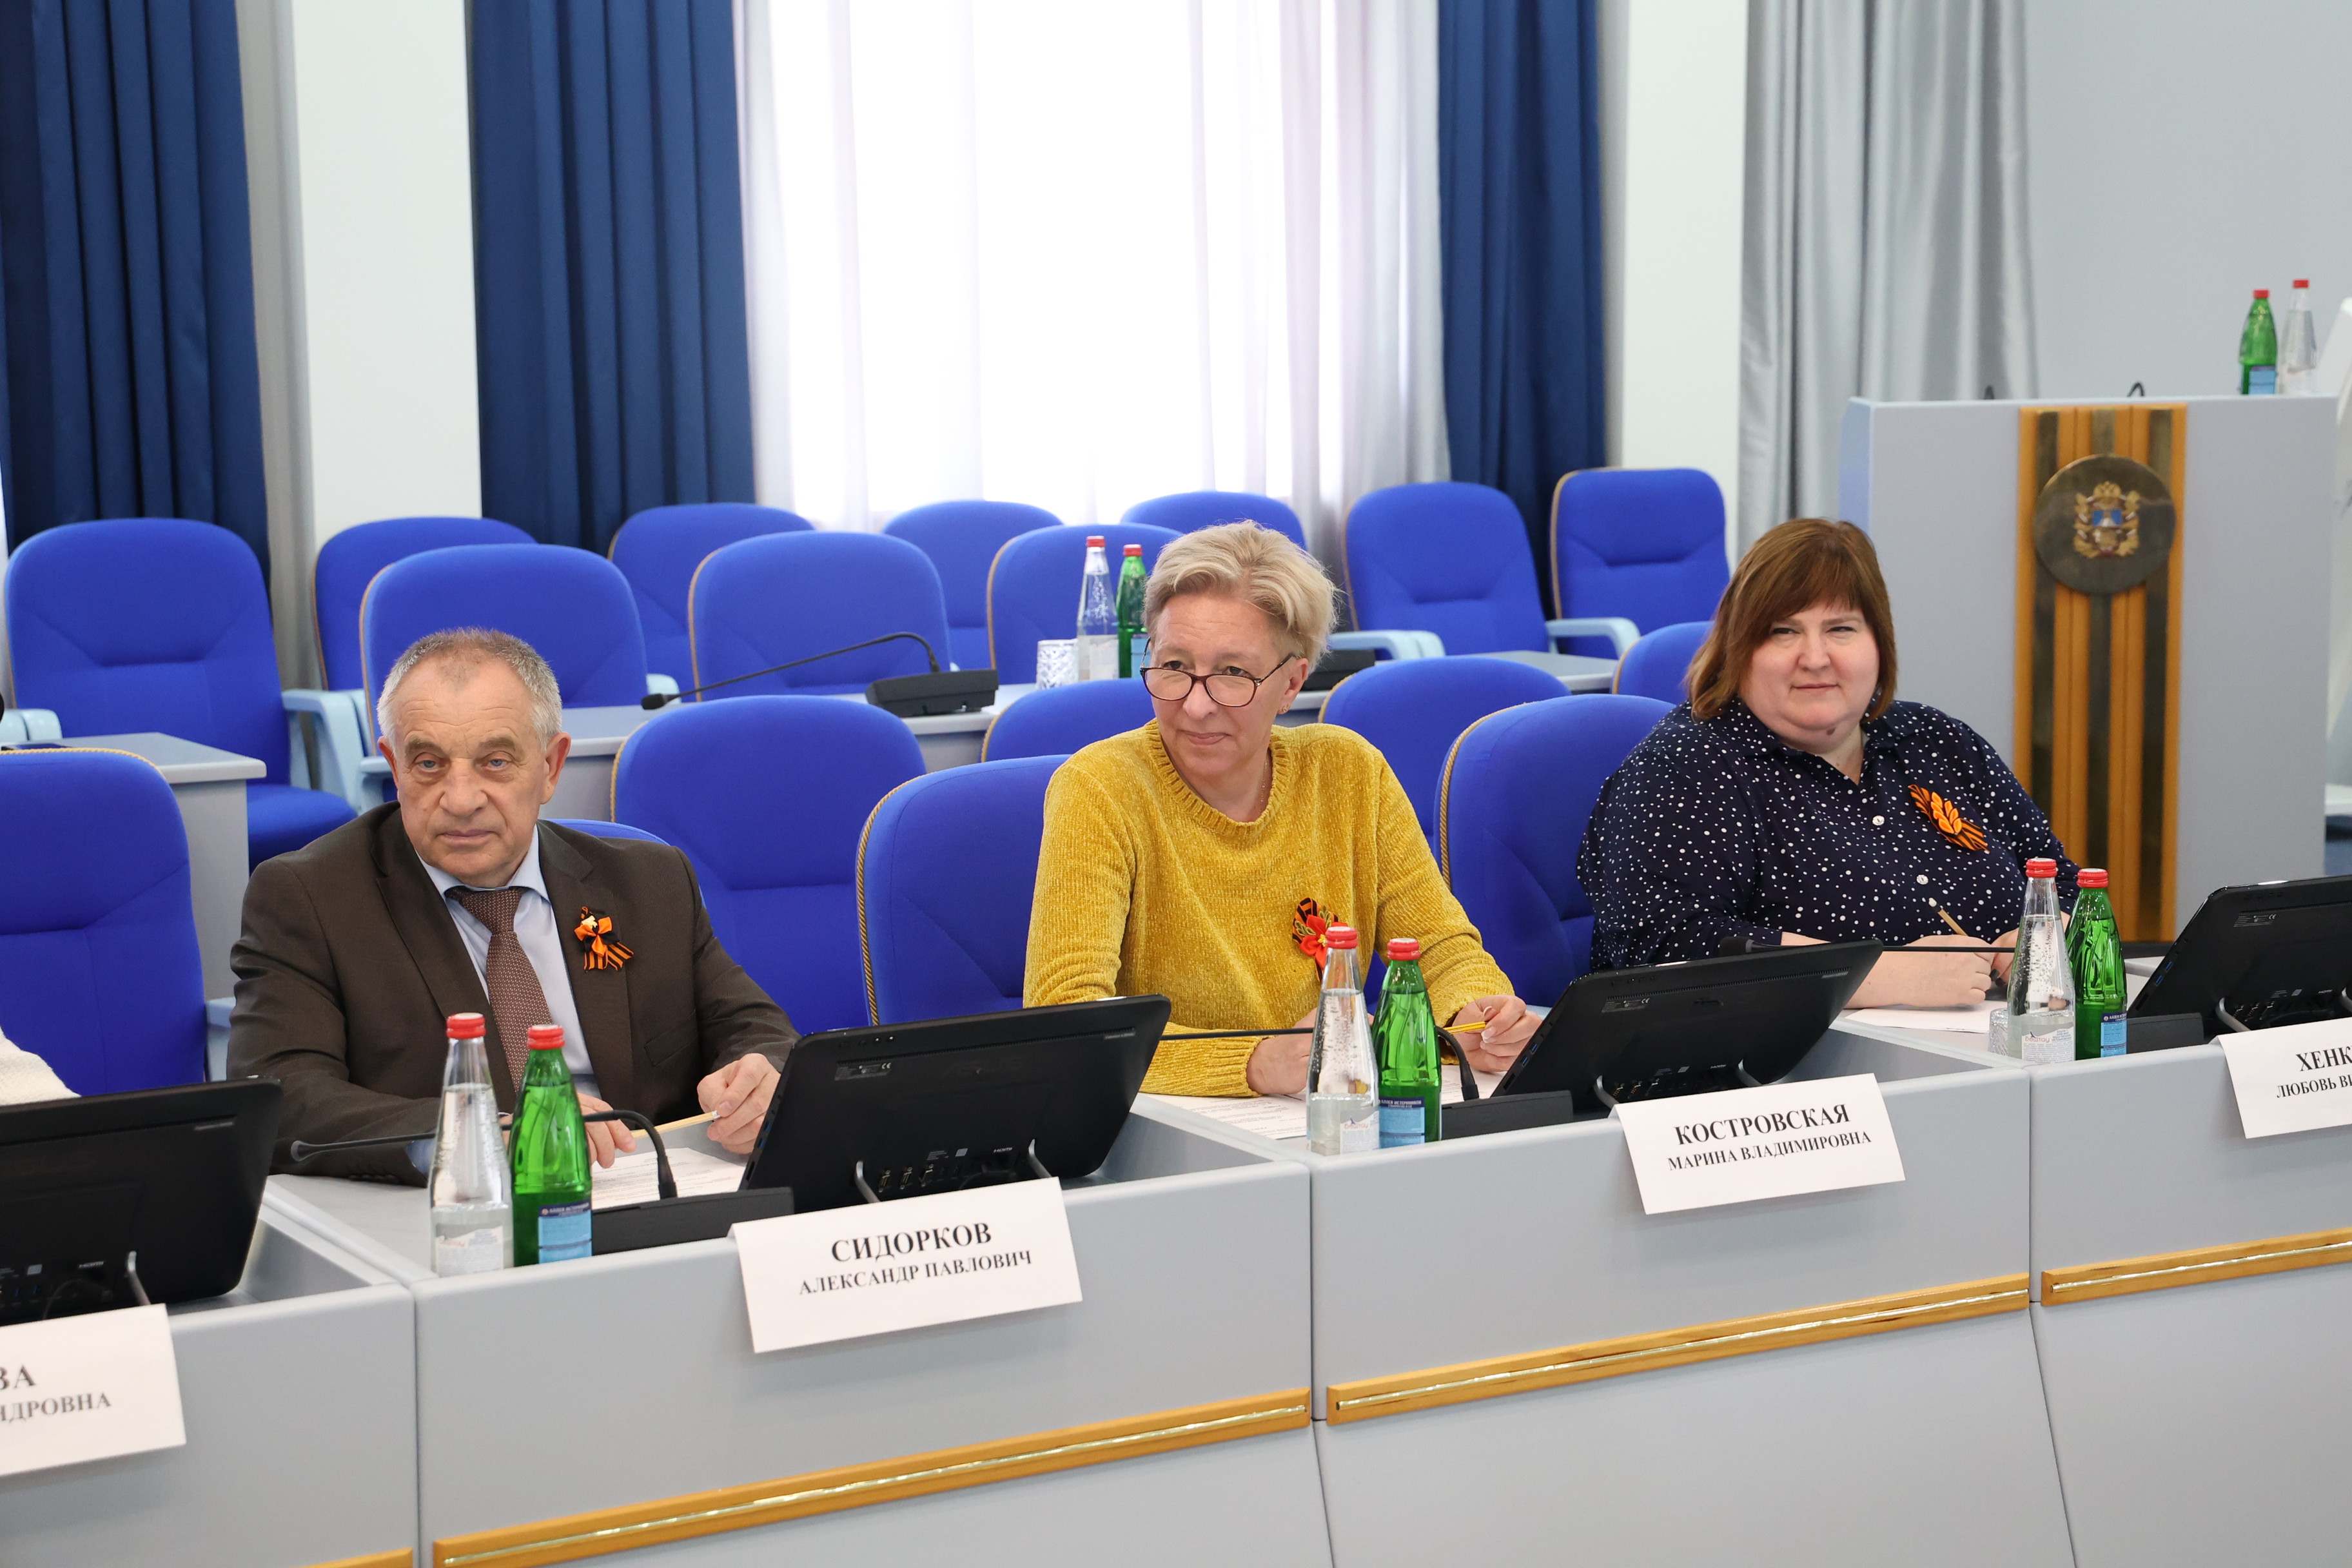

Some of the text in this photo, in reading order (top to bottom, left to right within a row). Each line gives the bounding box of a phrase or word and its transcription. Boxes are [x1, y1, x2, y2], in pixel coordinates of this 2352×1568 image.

[2295, 1045, 2352, 1072] ХЕНК
[2277, 1077, 2337, 1098] ЛЮБОВЬ
[1673, 1103, 1852, 1146] КОСТРОВСКАЯ
[1667, 1130, 1872, 1171] МАРИНА ВЛАДИМИРОВНА
[831, 1222, 992, 1262] СИДОРКОВ
[799, 1250, 1033, 1295] АЛЕКСАНДР ПАВЛОВИЧ
